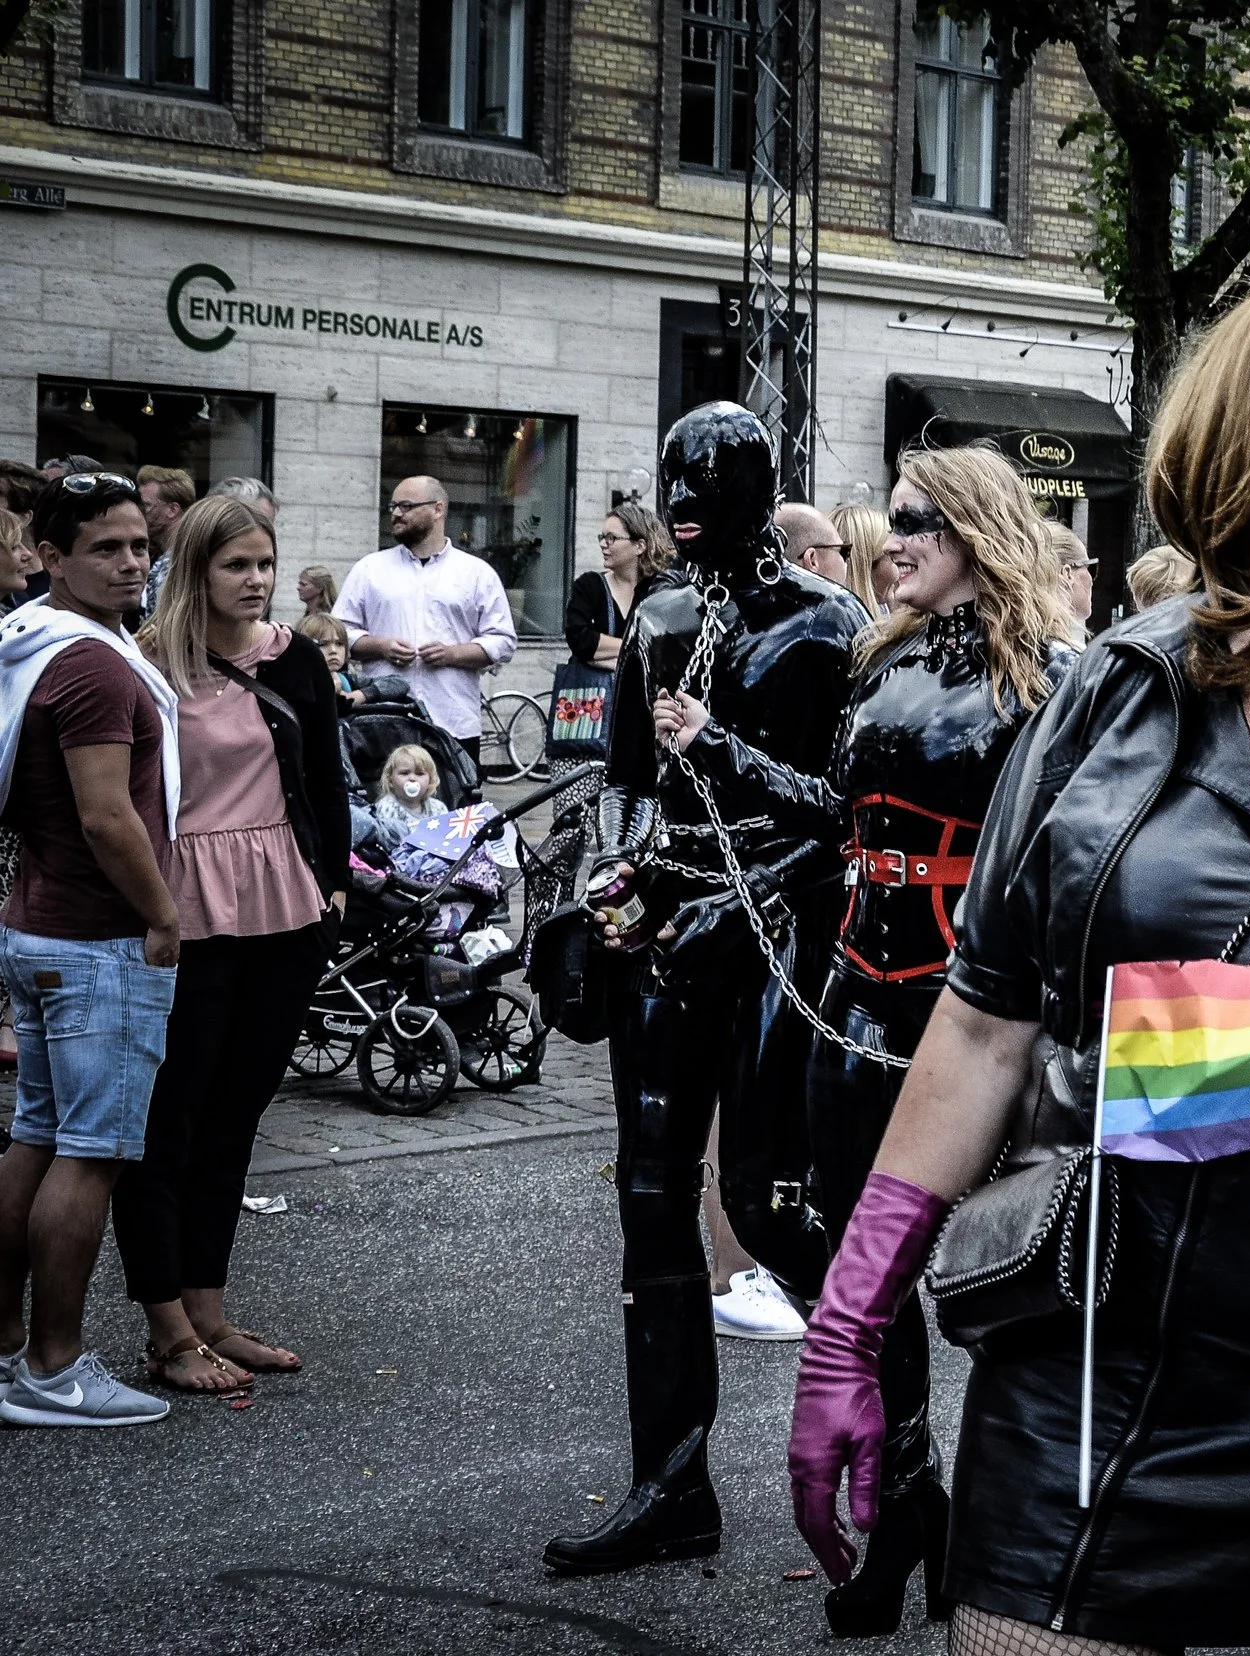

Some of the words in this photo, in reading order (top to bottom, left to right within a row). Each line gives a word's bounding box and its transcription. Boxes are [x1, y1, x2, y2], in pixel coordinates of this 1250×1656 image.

[167, 263, 294, 353] CENTRUM
[302, 308, 440, 343] PERSONALE
[446, 323, 484, 348] A/S
[727, 298, 745, 328] 3
[1028, 435, 1066, 465] Visage
